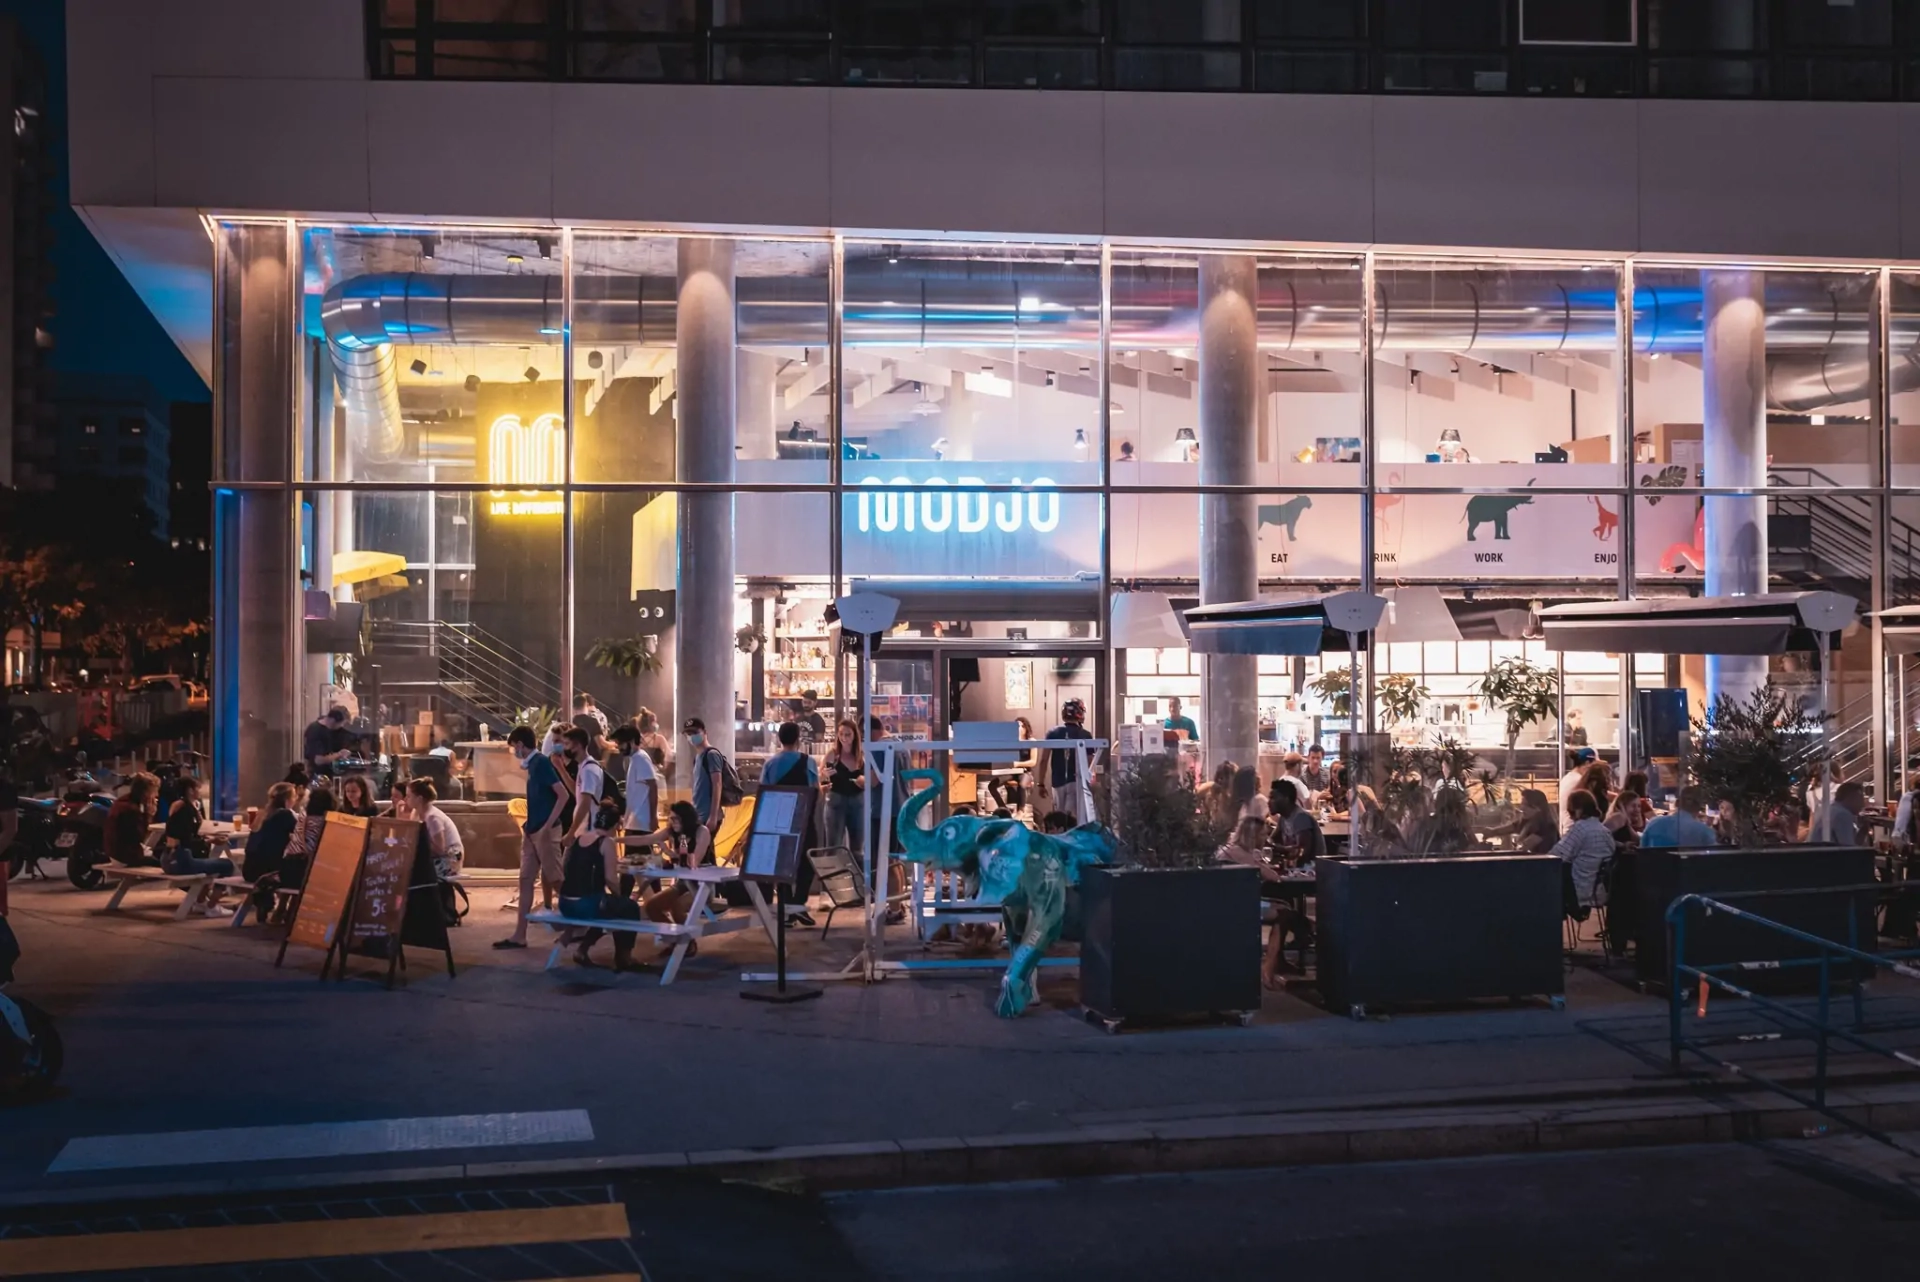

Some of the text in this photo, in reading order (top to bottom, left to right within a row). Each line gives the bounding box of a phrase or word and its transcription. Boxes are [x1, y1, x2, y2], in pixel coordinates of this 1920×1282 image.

[858, 476, 1060, 533] MODJO
[1271, 553, 1288, 563] EAT
[1374, 552, 1397, 563] RINK
[1474, 552, 1504, 563] WORK
[1594, 553, 1618, 565] ENJO
